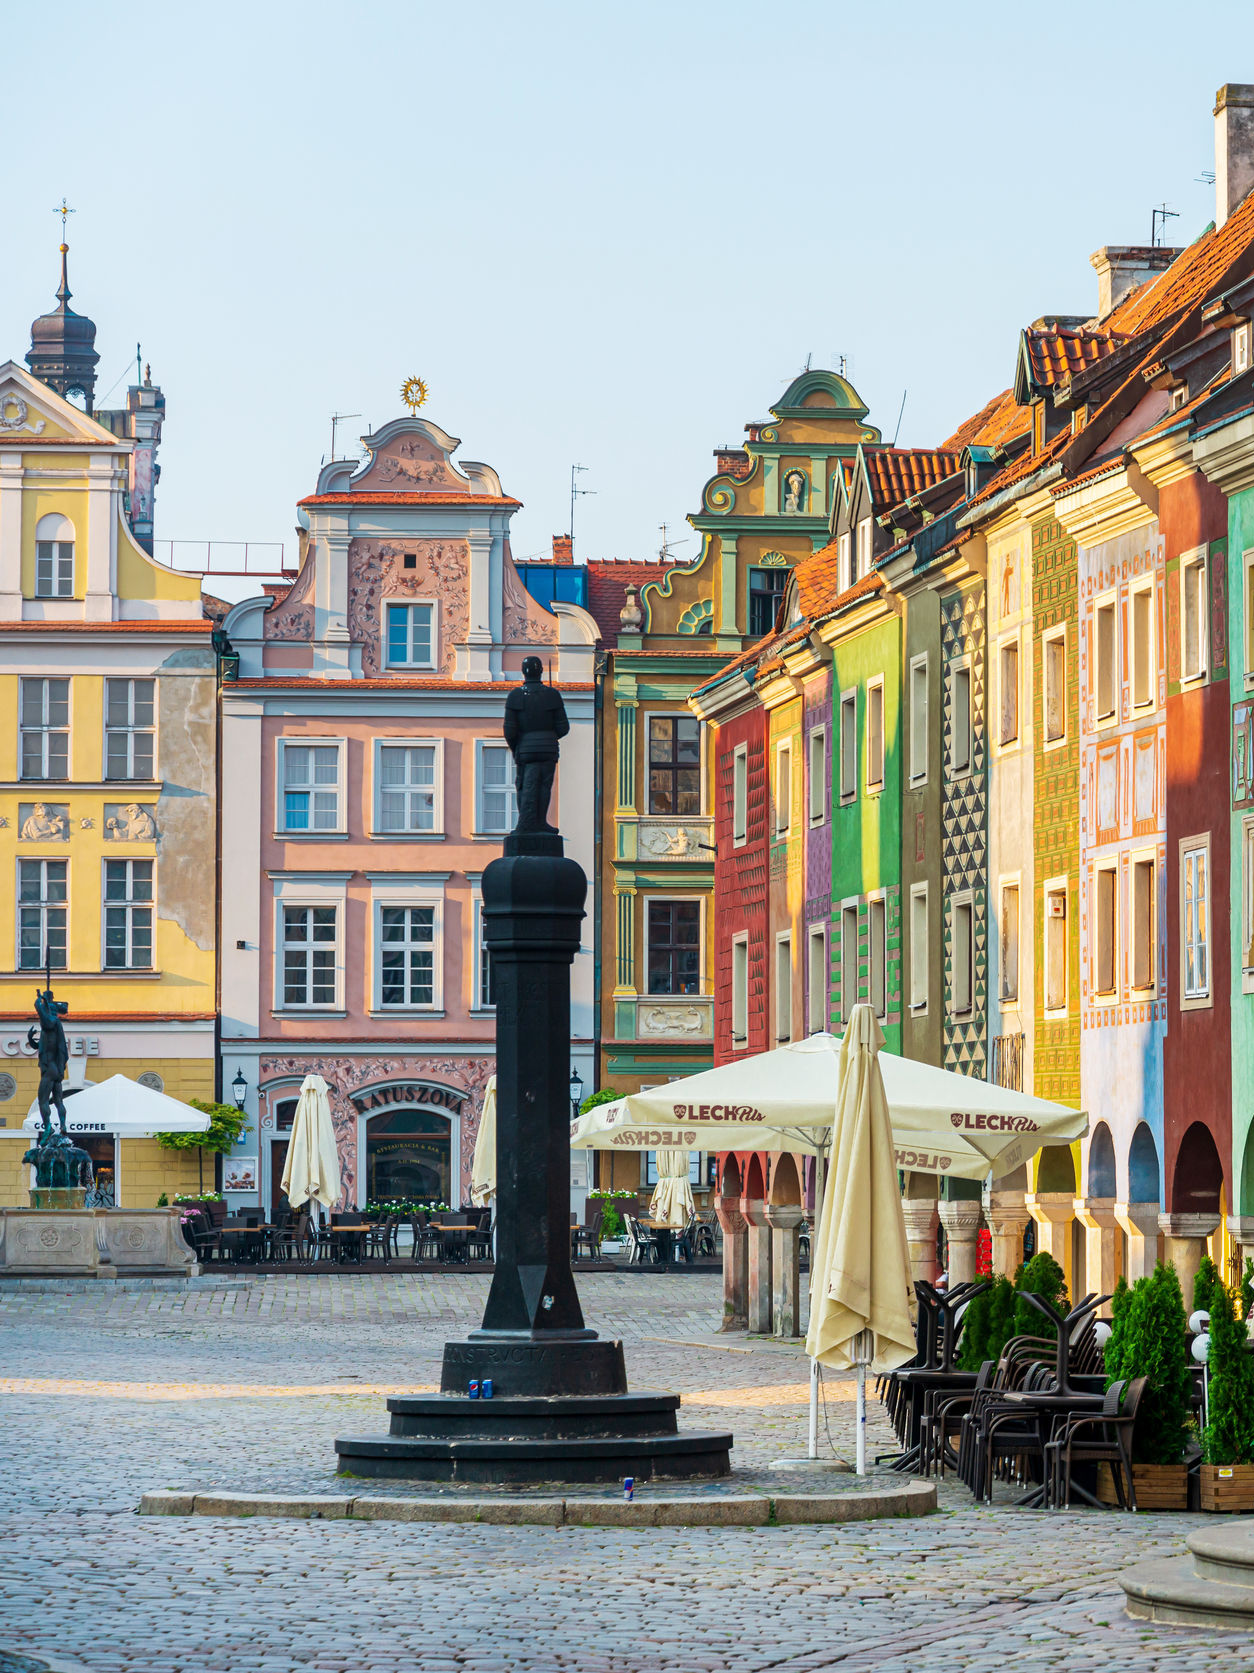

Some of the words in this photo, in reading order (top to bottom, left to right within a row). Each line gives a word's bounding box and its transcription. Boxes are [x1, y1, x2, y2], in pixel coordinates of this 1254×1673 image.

[2, 1037, 99, 1056] COEE
[688, 1105, 737, 1121] LECH
[965, 1113, 1012, 1131] LECH
